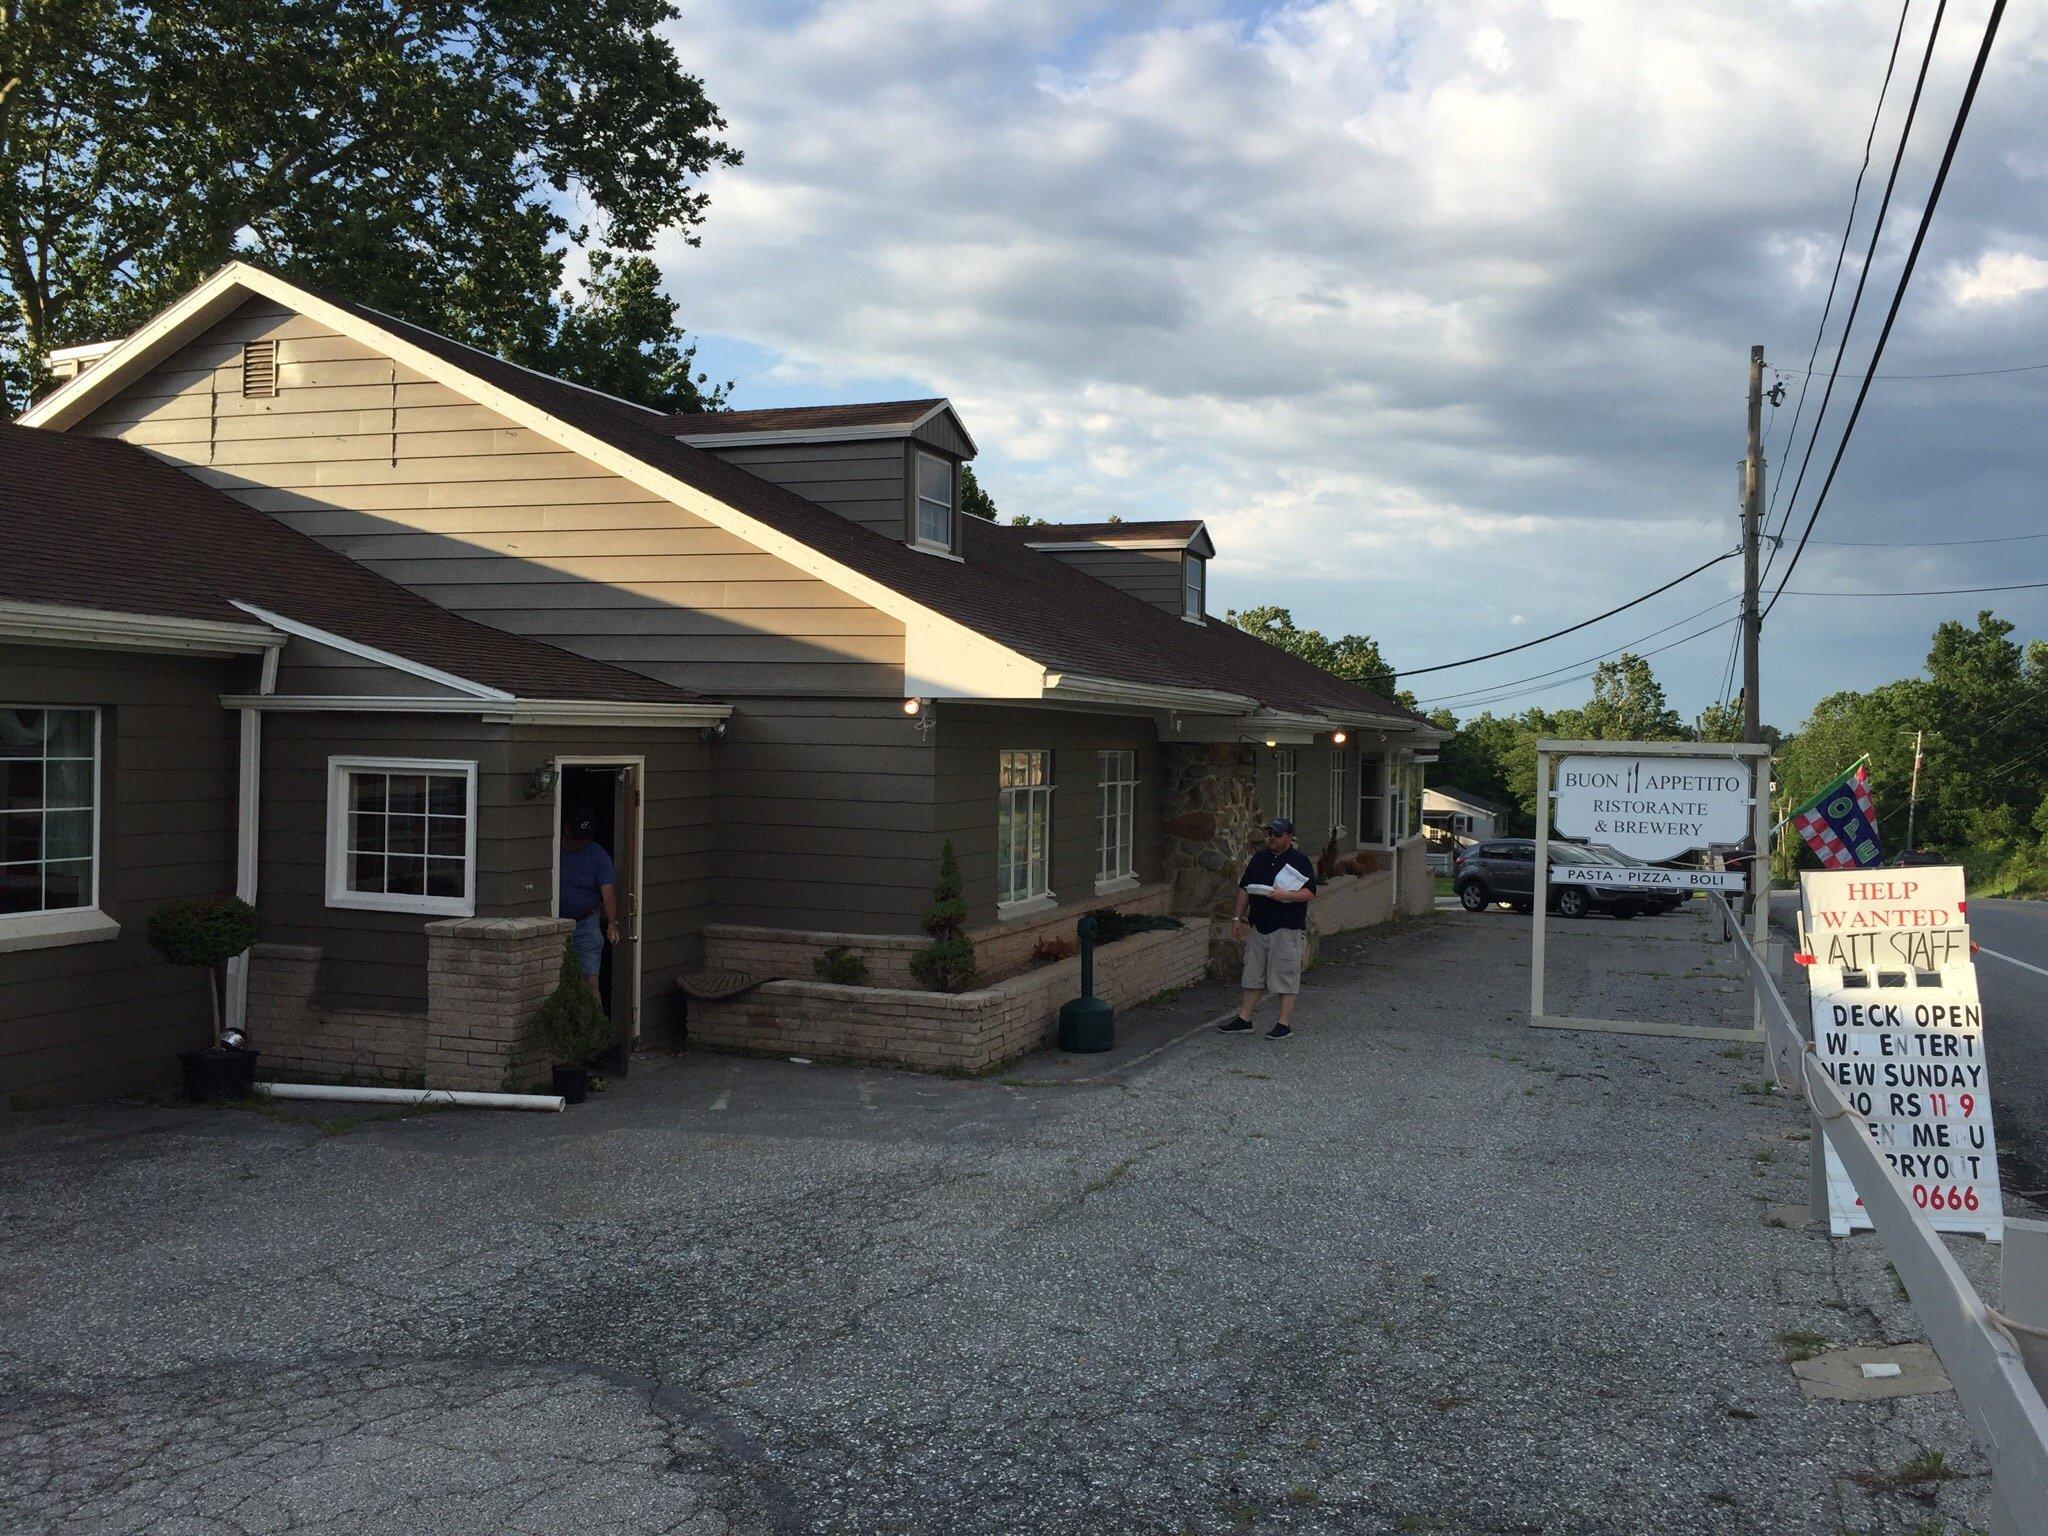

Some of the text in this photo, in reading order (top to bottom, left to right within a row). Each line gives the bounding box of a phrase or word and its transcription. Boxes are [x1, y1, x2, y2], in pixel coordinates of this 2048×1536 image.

[1565, 773, 1740, 792] BUON APPETITO
[1593, 799, 1708, 816] RISTORANTE
[1594, 820, 1703, 836] & BREWERY
[1827, 796, 1879, 865] OPE
[1568, 870, 1724, 886] PASTA PIZZA BOLI
[1847, 881, 1918, 901] HELP
[1820, 909, 1950, 928] WANTED
[1890, 930, 1963, 971] STAFF
[1833, 1005, 1980, 1027] DECK OPEN
[1884, 1063, 1981, 1088] SUNDAY
